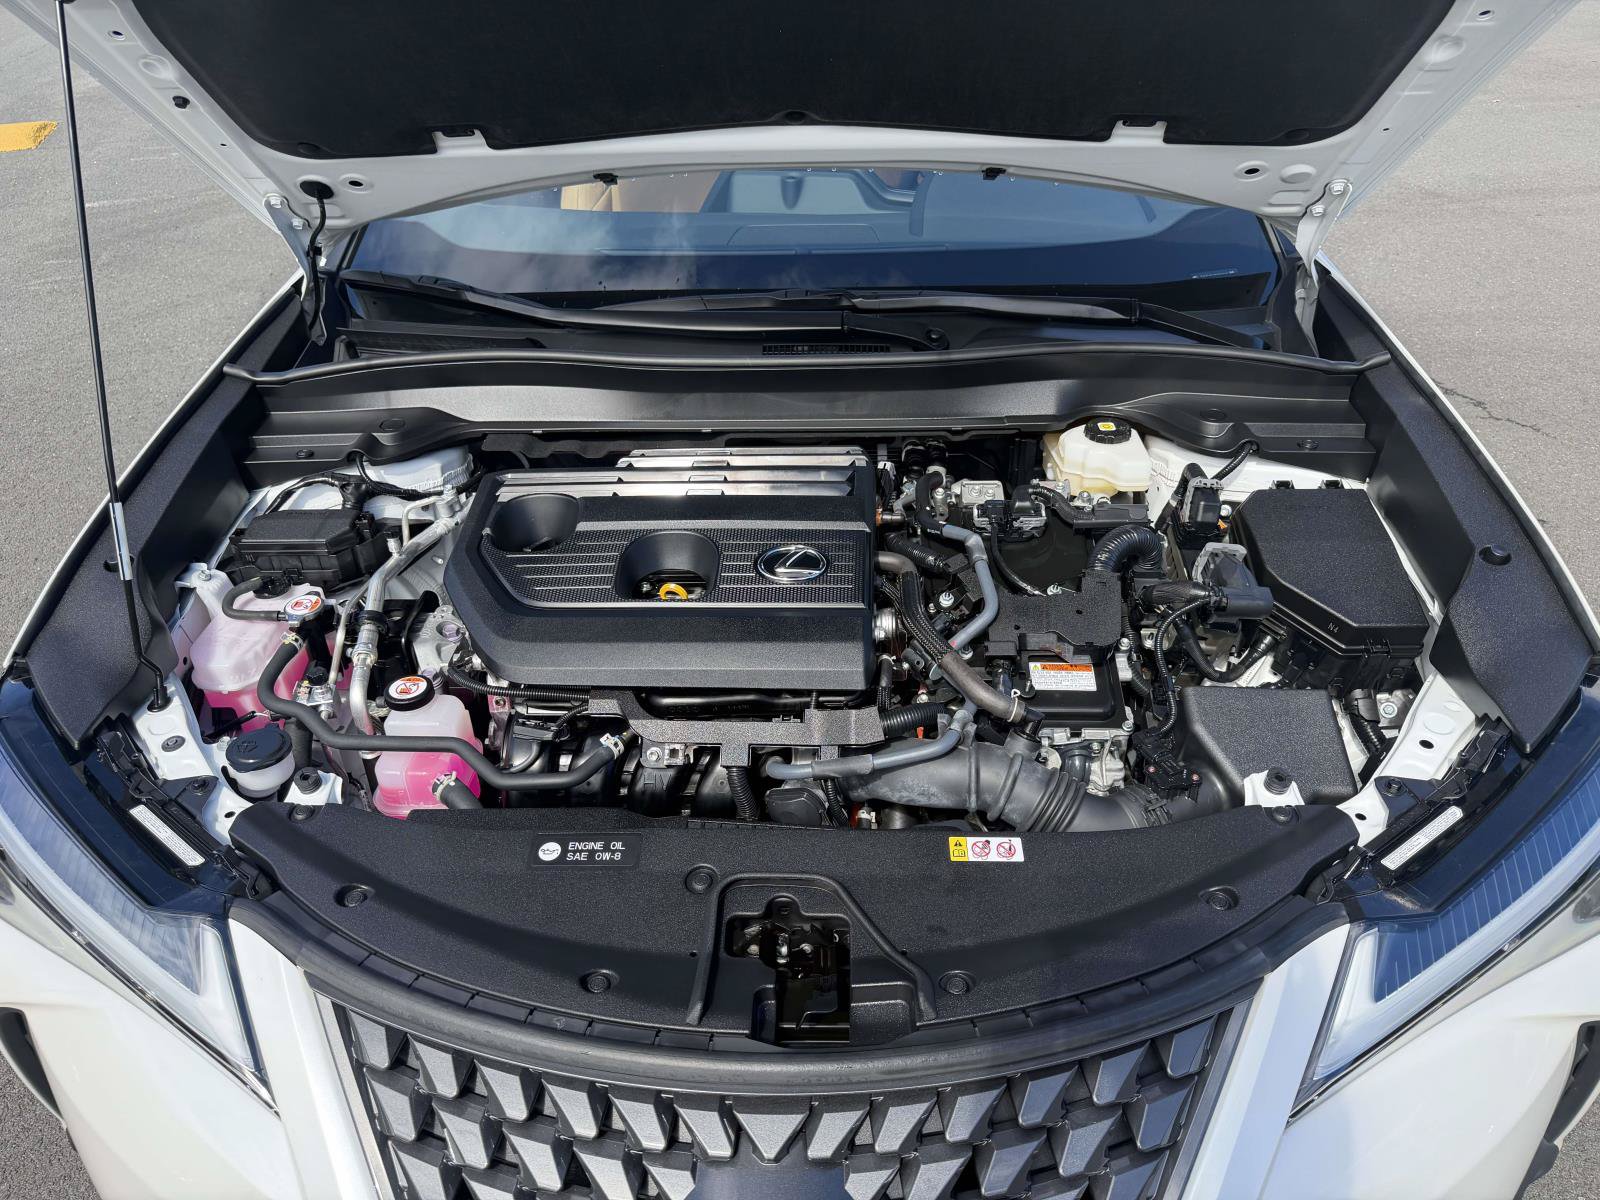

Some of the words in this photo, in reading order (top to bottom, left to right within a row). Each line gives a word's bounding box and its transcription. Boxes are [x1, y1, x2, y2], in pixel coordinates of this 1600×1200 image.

[568, 842, 604, 850] ENGINE
[610, 842, 625, 850] OIL
[566, 852, 588, 861] SAE
[595, 852, 621, 861] 0W-8
